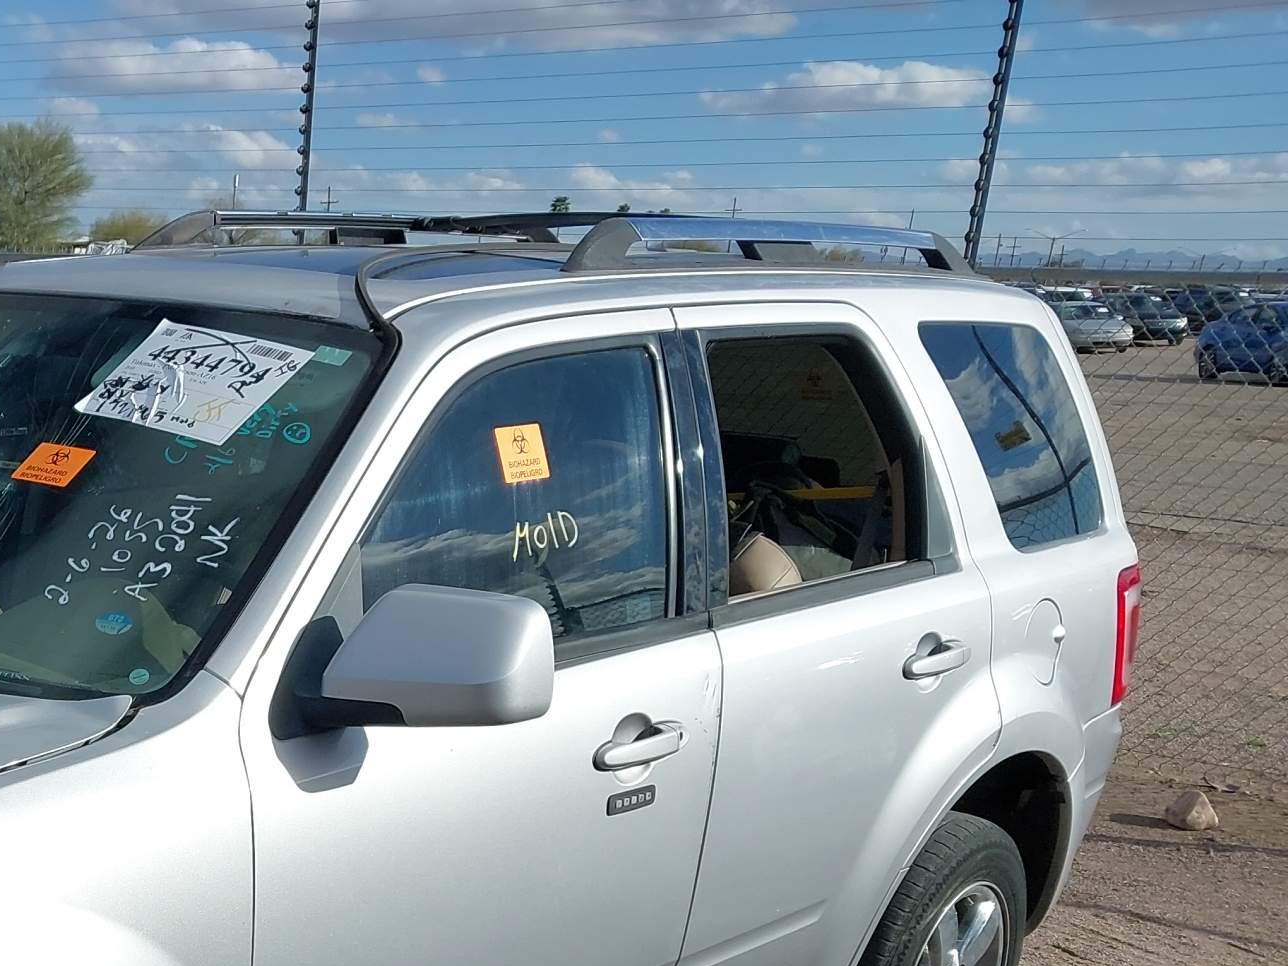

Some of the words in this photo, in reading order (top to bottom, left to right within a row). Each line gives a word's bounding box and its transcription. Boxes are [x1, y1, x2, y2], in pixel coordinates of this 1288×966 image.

[25, 464, 69, 477] BIOHAZARD
[508, 457, 541, 469] BIOHAZARD
[510, 468, 543, 480] BIOPELIGRO
[19, 471, 62, 484] BIOPELIGRO
[44, 504, 132, 605] 2-6-26
[100, 512, 163, 571] 1055
[196, 517, 241, 568] NK
[124, 561, 172, 601] A3
